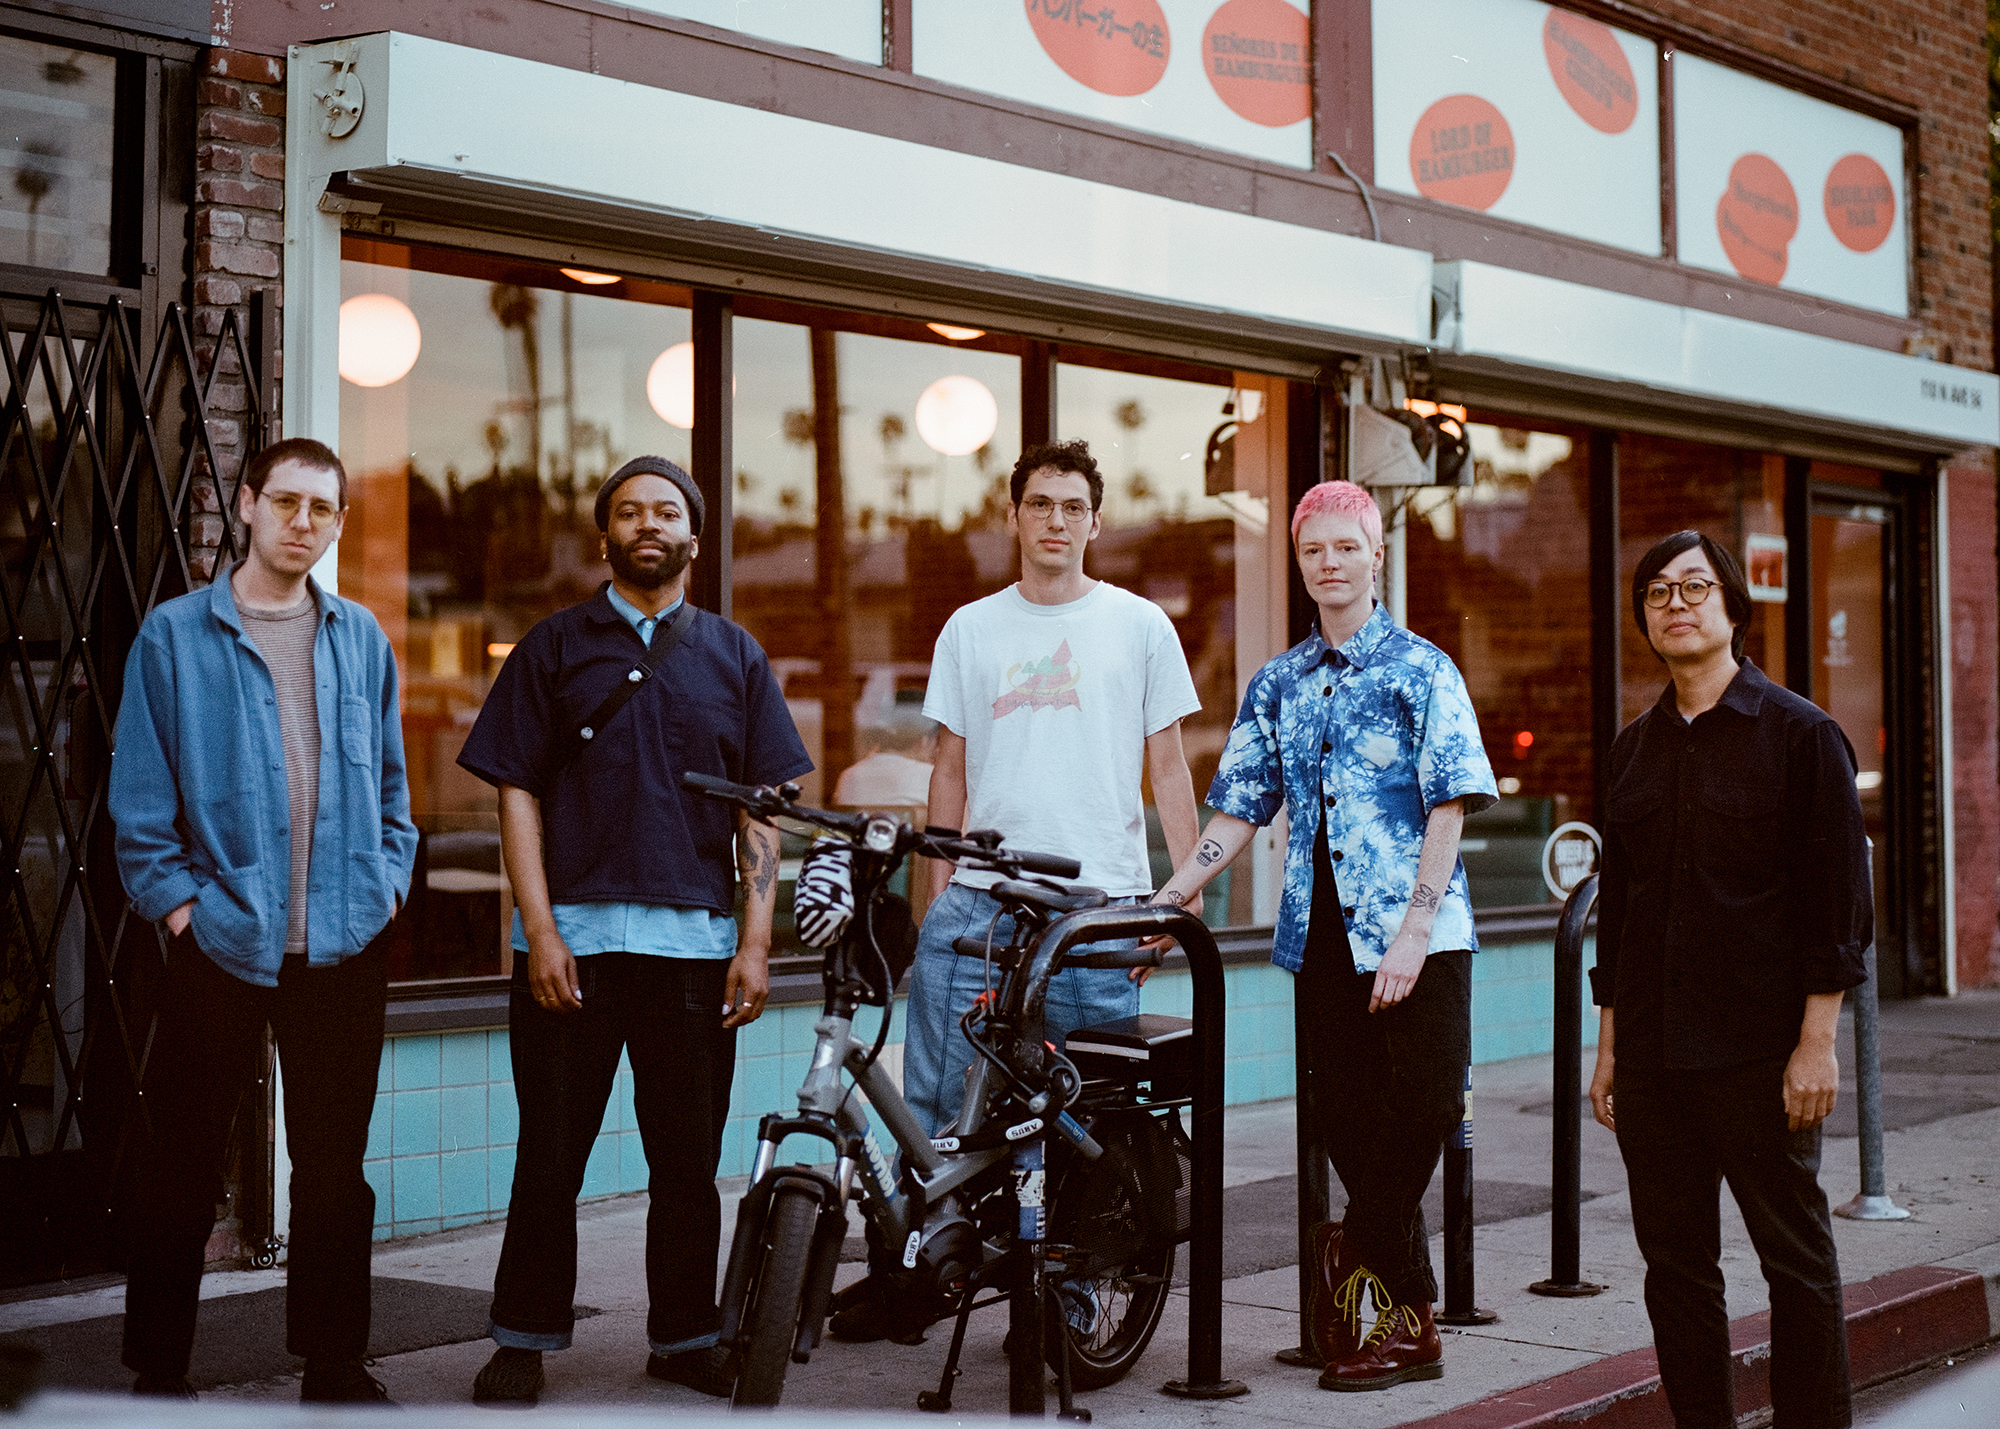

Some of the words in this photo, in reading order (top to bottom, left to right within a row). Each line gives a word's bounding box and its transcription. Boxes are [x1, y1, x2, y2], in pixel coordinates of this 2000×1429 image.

[1430, 125, 1471, 154] LORD
[1474, 122, 1492, 146] OF
[1010, 1121, 1043, 1139] ABUS
[906, 1235, 919, 1263] ABUS
